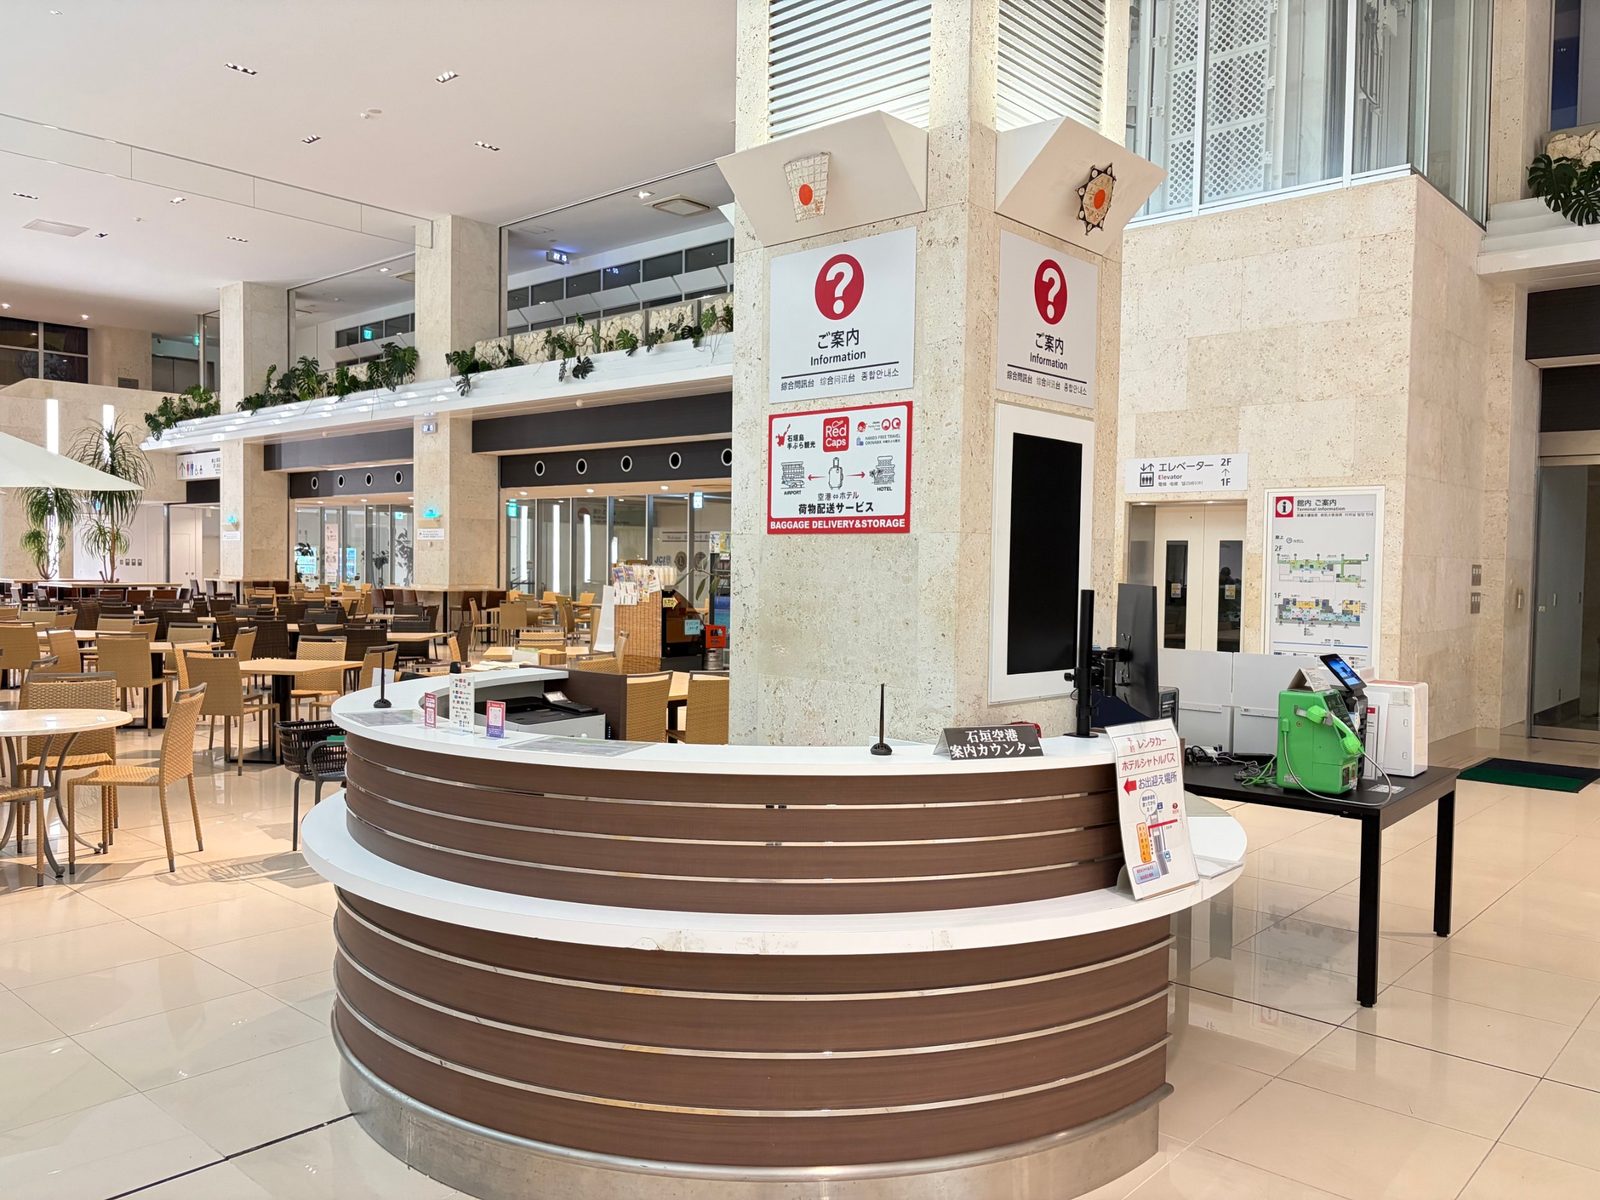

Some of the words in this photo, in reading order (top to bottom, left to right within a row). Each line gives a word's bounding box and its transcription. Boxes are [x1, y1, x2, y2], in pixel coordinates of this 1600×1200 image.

[817, 328, 860, 349] ご案内
[1035, 332, 1064, 356] ご案内
[810, 350, 866, 366] Information
[1030, 352, 1068, 371] Information
[861, 368, 899, 382] 종합안내소
[825, 424, 847, 437] Red
[825, 438, 847, 449] Caps
[1158, 461, 1214, 472] エレベーター
[1220, 458, 1232, 467] 2F
[1220, 478, 1231, 487] 1F
[817, 493, 832, 501] 空港
[839, 491, 860, 500] ホテル
[1315, 499, 1337, 507] ご案内
[798, 501, 874, 515] 荷物配送サービス
[770, 520, 810, 530] BAGGAGE
[812, 518, 906, 529] DELIVERY&STORAGE
[965, 728, 1019, 744] 石垣空港
[1137, 737, 1167, 749] レンタカー
[949, 742, 1041, 760] 案内カウンター
[1122, 753, 1176, 771] ホテルシャトルバス
[1138, 771, 1177, 789] お出迎え場所
